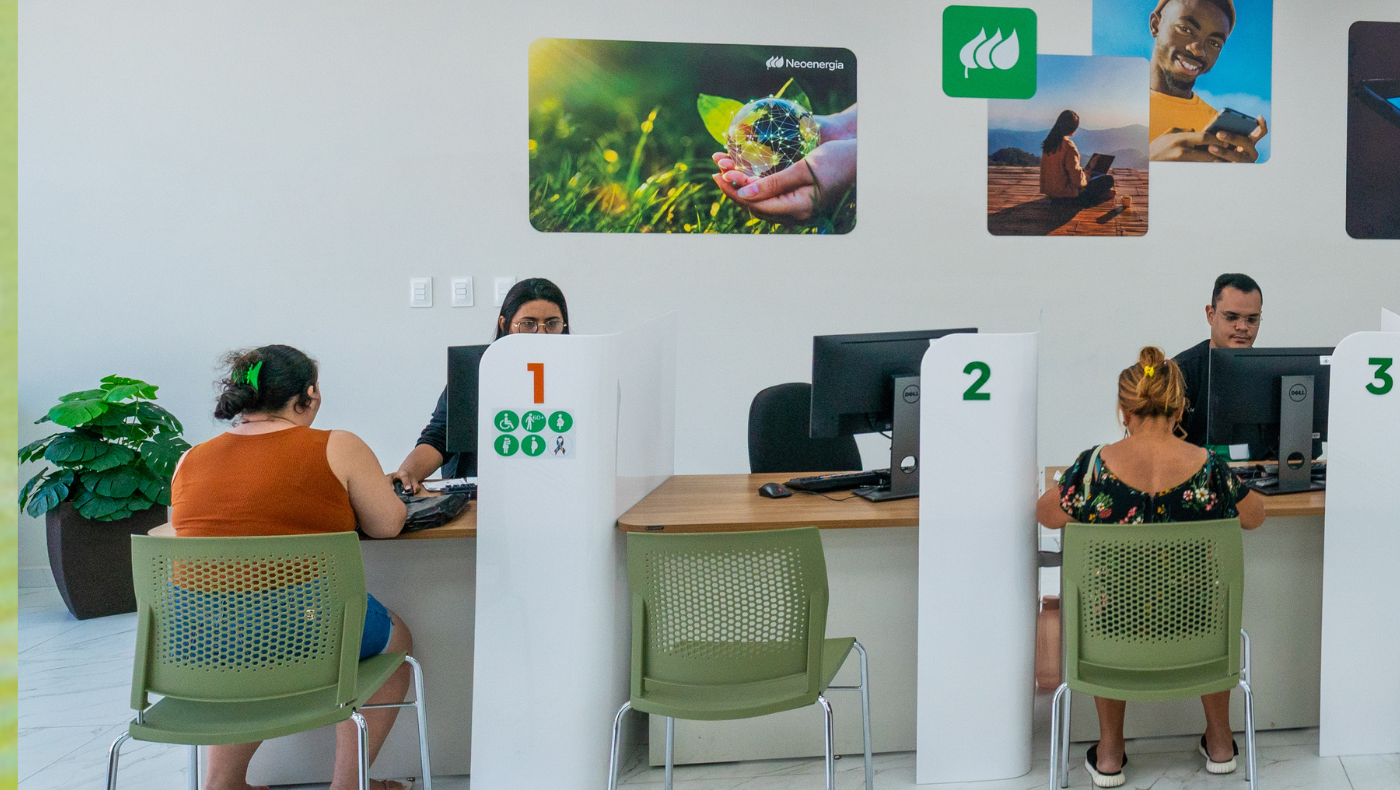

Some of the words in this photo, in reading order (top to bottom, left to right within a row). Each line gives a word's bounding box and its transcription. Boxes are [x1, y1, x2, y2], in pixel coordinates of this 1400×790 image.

[785, 58, 844, 72] Neoenergia
[526, 362, 545, 404] 1
[963, 360, 991, 401] 2
[1366, 357, 1393, 396] 3
